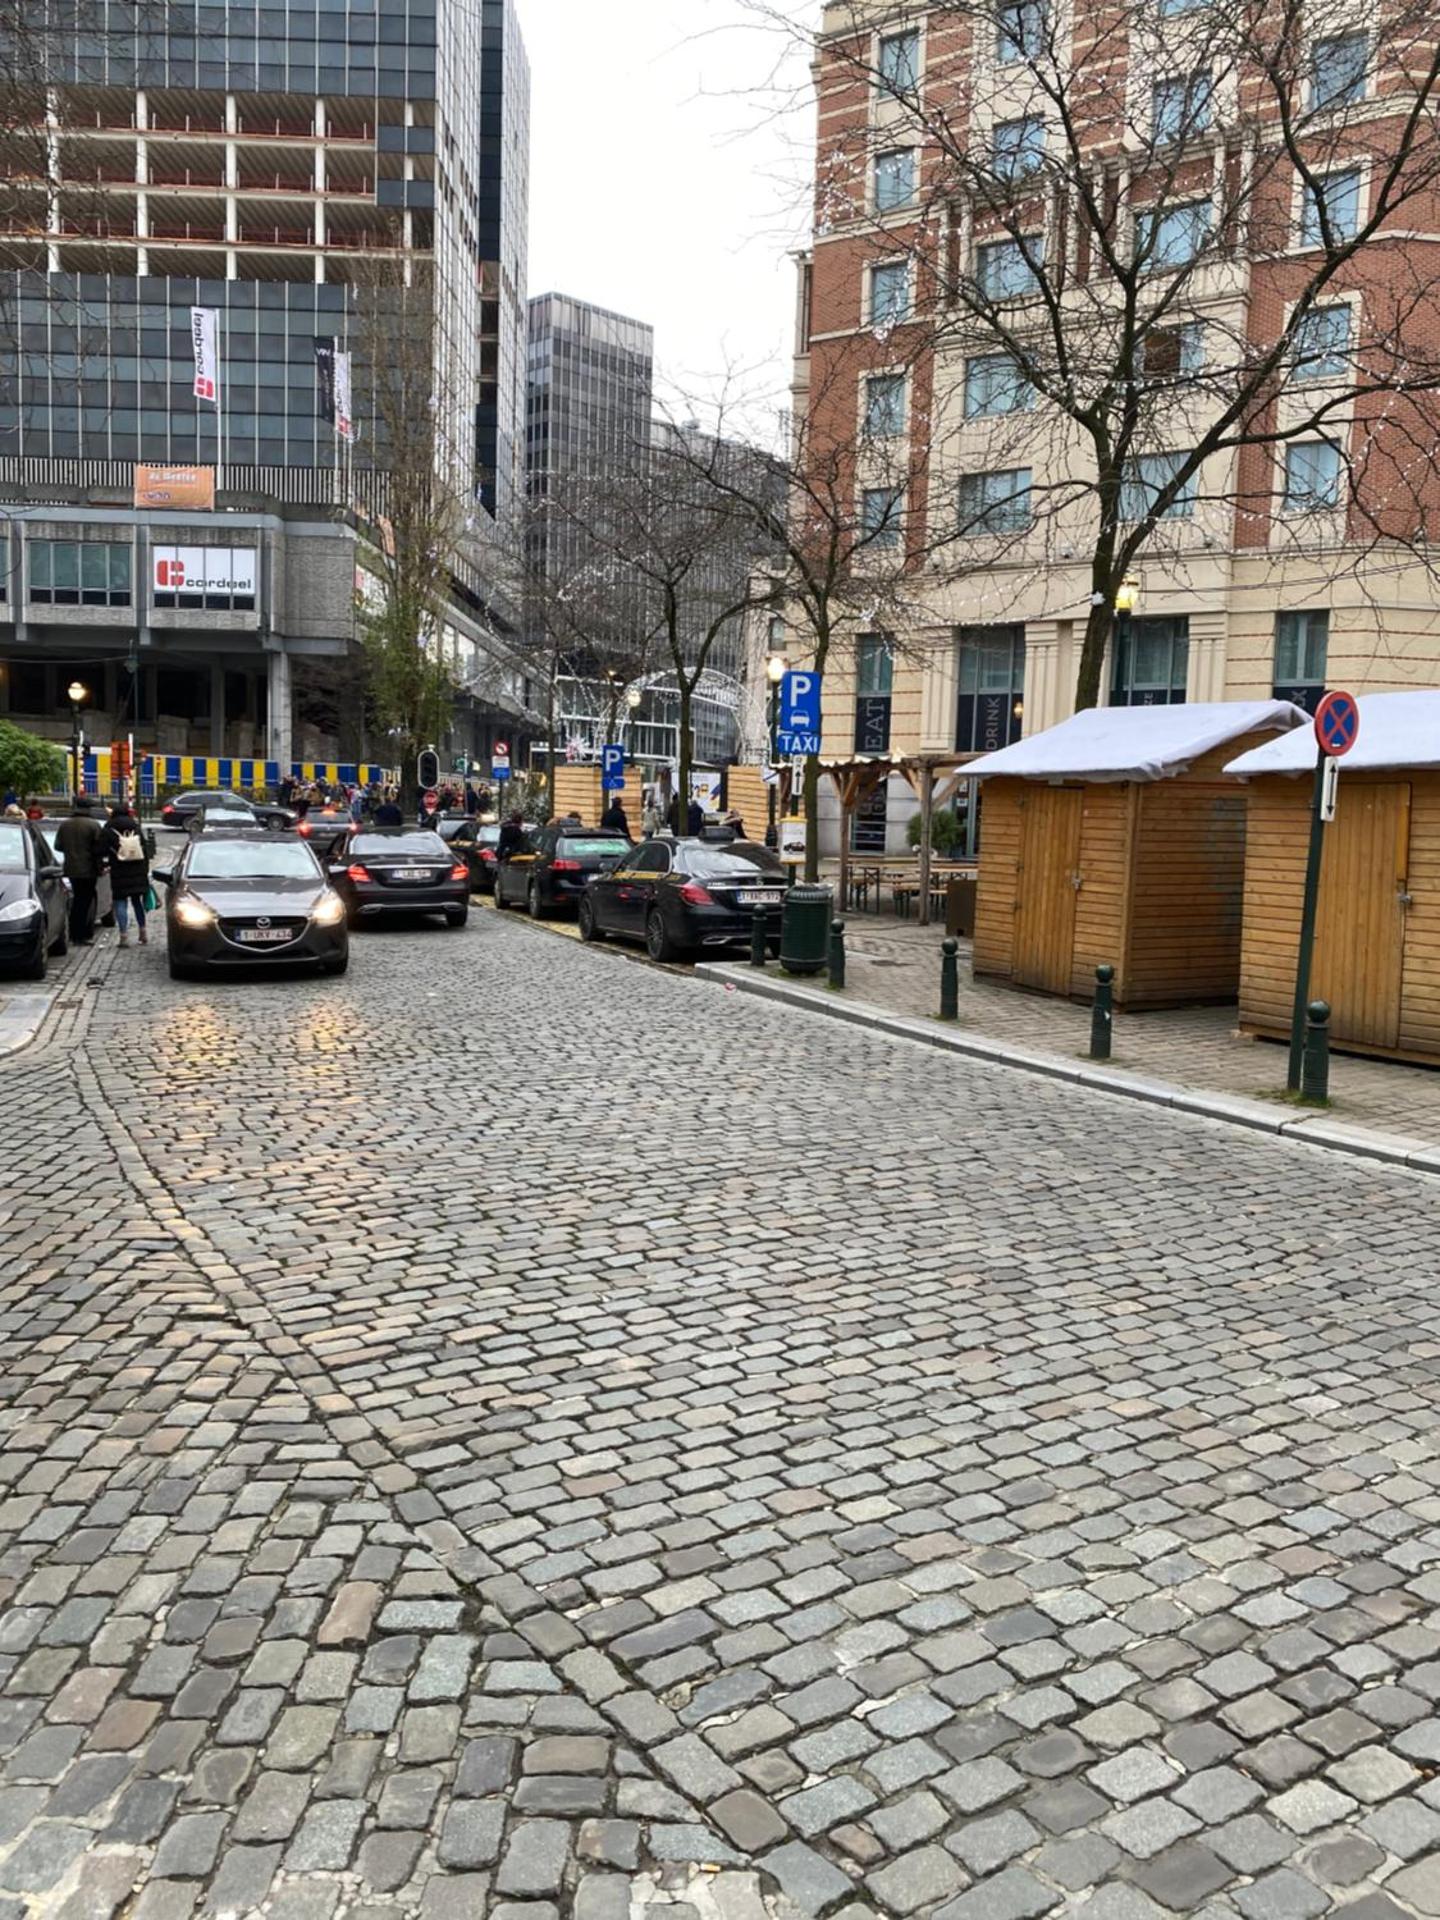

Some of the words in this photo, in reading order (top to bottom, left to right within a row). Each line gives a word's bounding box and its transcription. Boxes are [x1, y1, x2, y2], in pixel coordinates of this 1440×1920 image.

[186, 578, 252, 590] cordeel
[790, 675, 811, 707] P
[865, 699, 885, 750] EAT
[985, 697, 1000, 750] DRINK
[781, 735, 818, 752] TAXI
[605, 749, 620, 772] P
